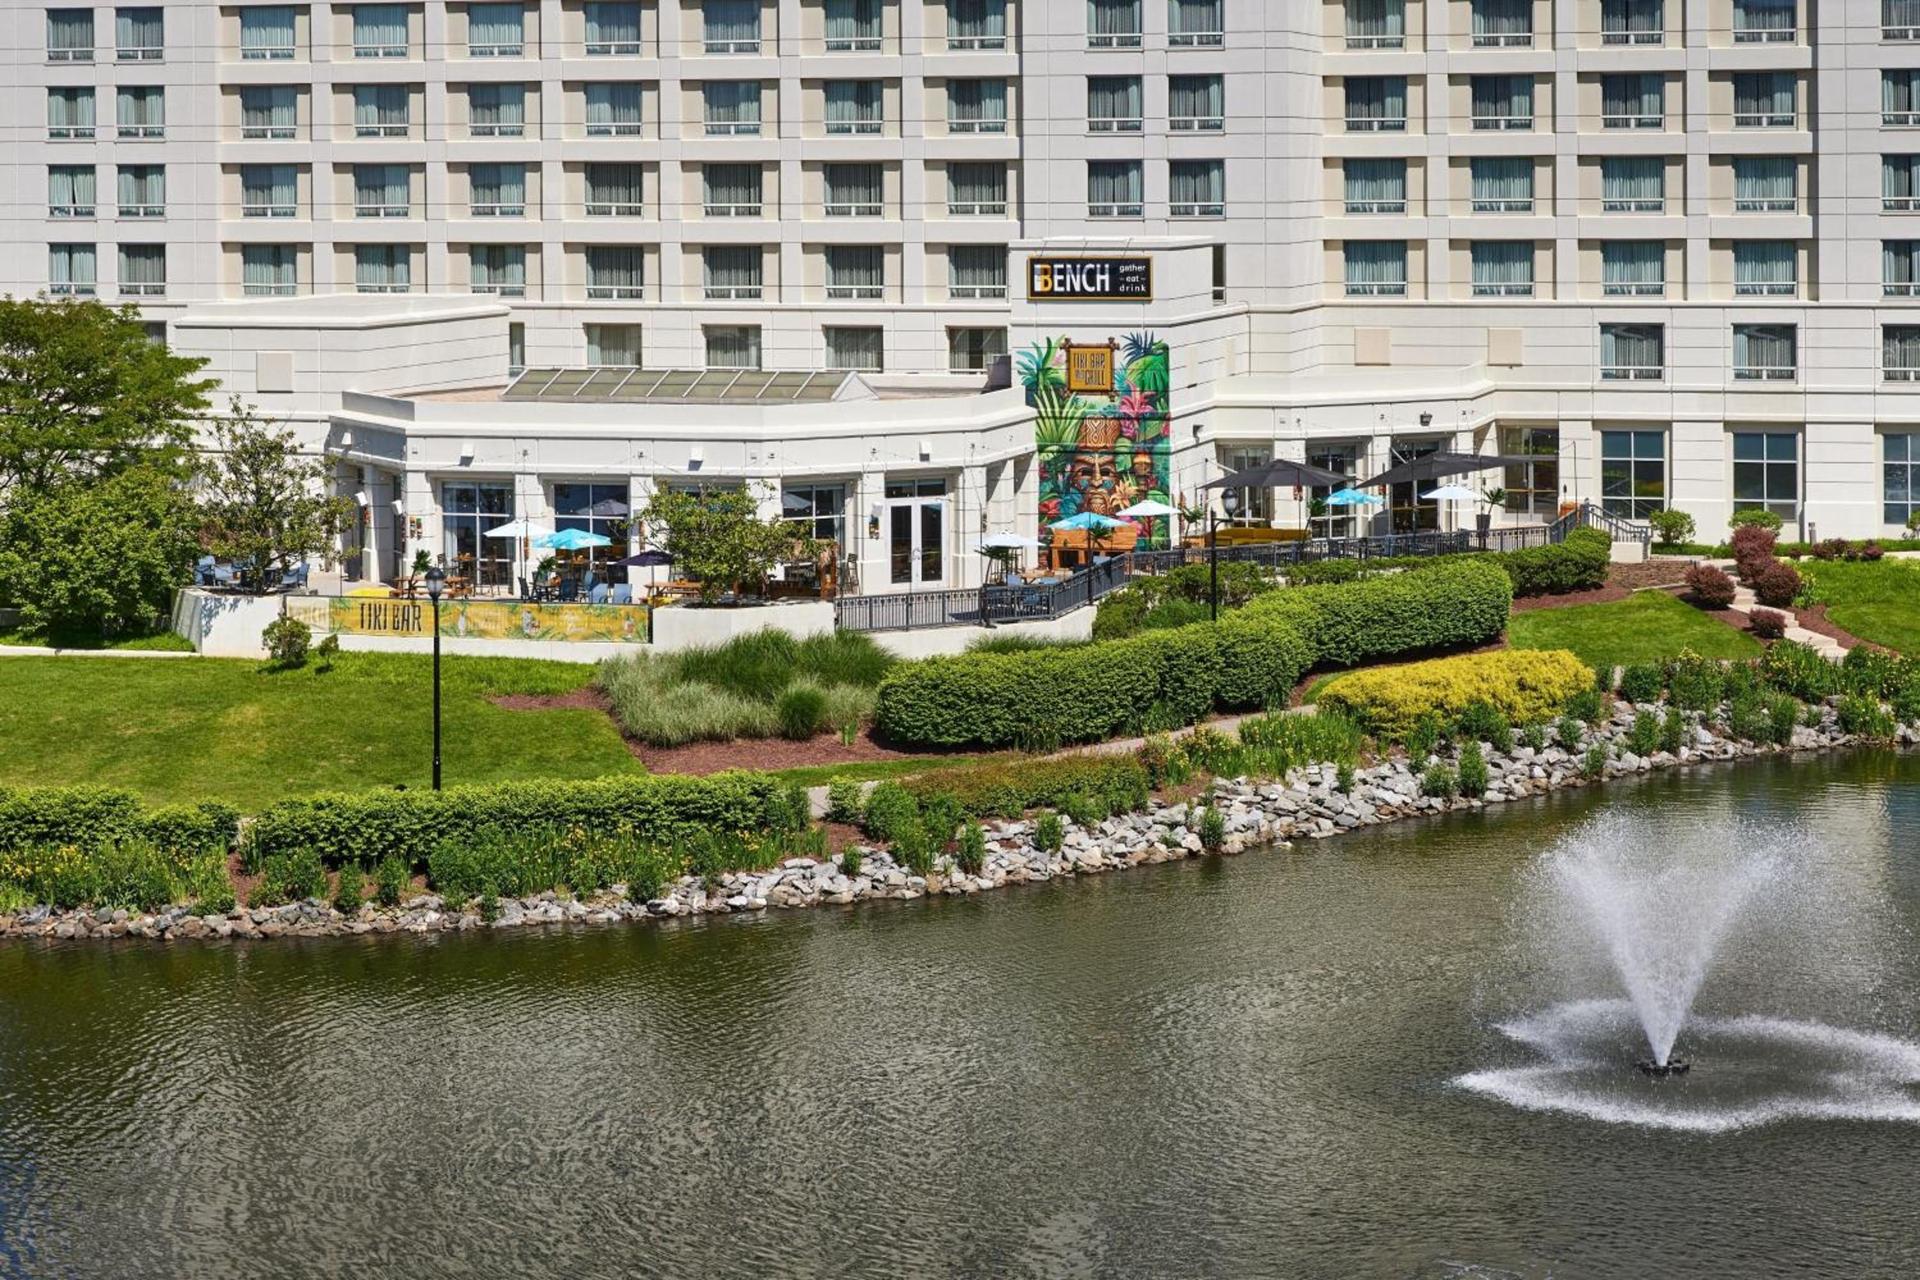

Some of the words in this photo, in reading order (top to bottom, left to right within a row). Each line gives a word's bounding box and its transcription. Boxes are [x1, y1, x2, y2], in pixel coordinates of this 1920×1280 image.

[1119, 264, 1146, 273] gather
[1034, 263, 1110, 292] BENCH
[1119, 284, 1146, 292] drink
[1073, 353, 1088, 369] TIKI
[1090, 353, 1106, 369] BAR
[1084, 369, 1106, 386] GRILL
[360, 603, 388, 630] TIKI
[392, 604, 422, 632] BAR
